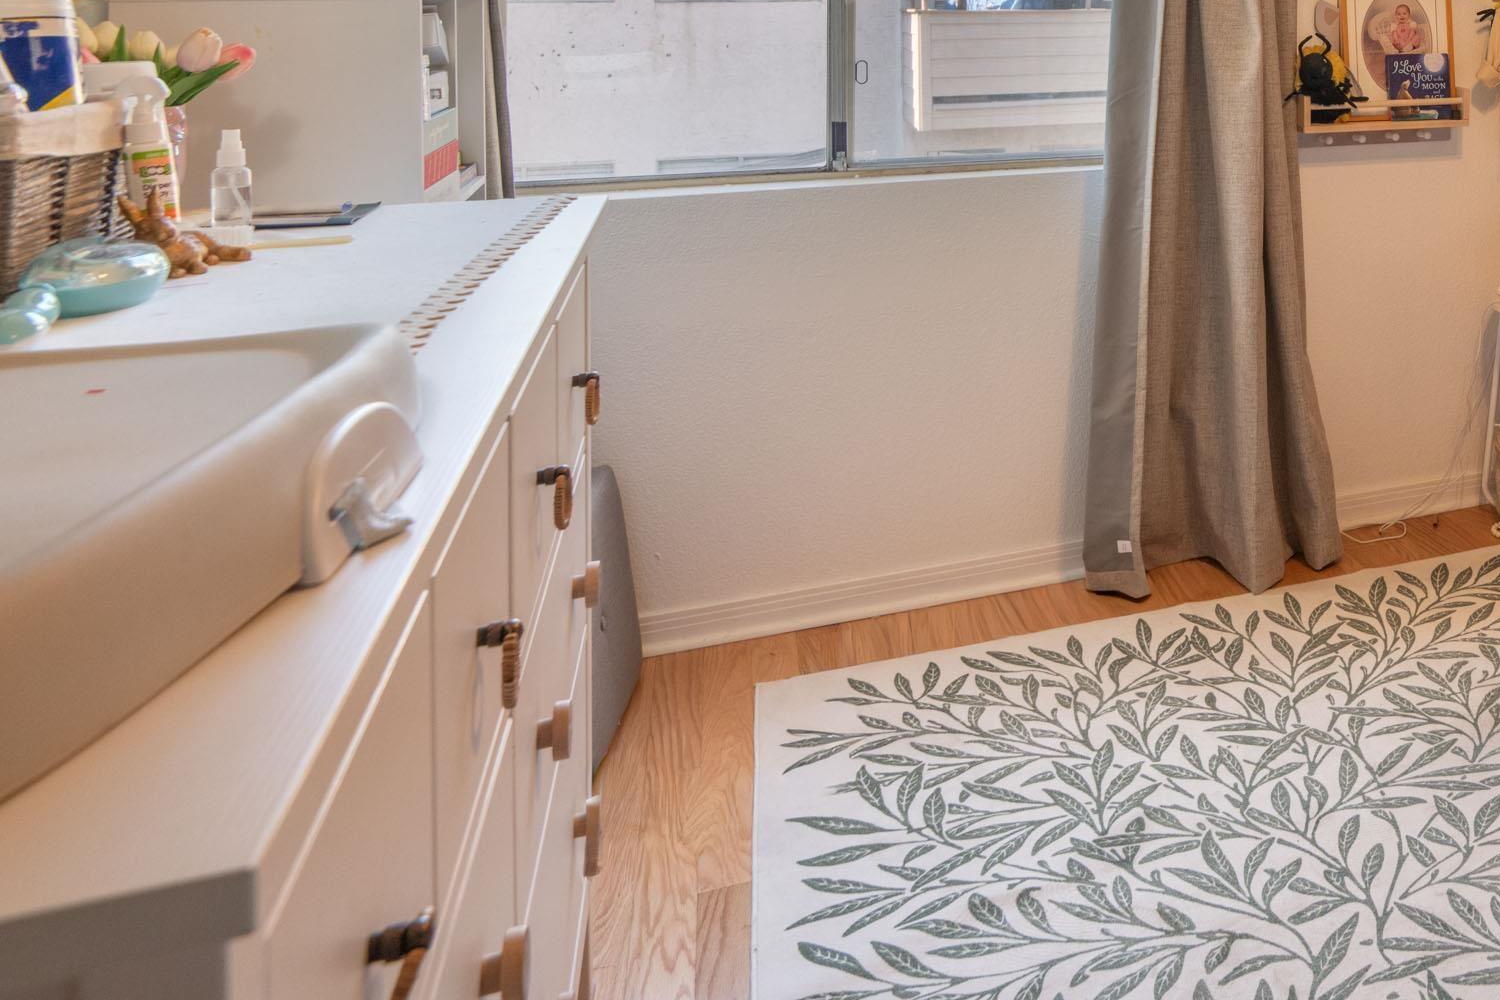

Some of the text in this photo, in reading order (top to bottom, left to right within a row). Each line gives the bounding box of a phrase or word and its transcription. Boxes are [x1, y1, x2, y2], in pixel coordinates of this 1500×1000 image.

[1392, 59, 1423, 75] I Love
[1421, 82, 1446, 90] MOON
